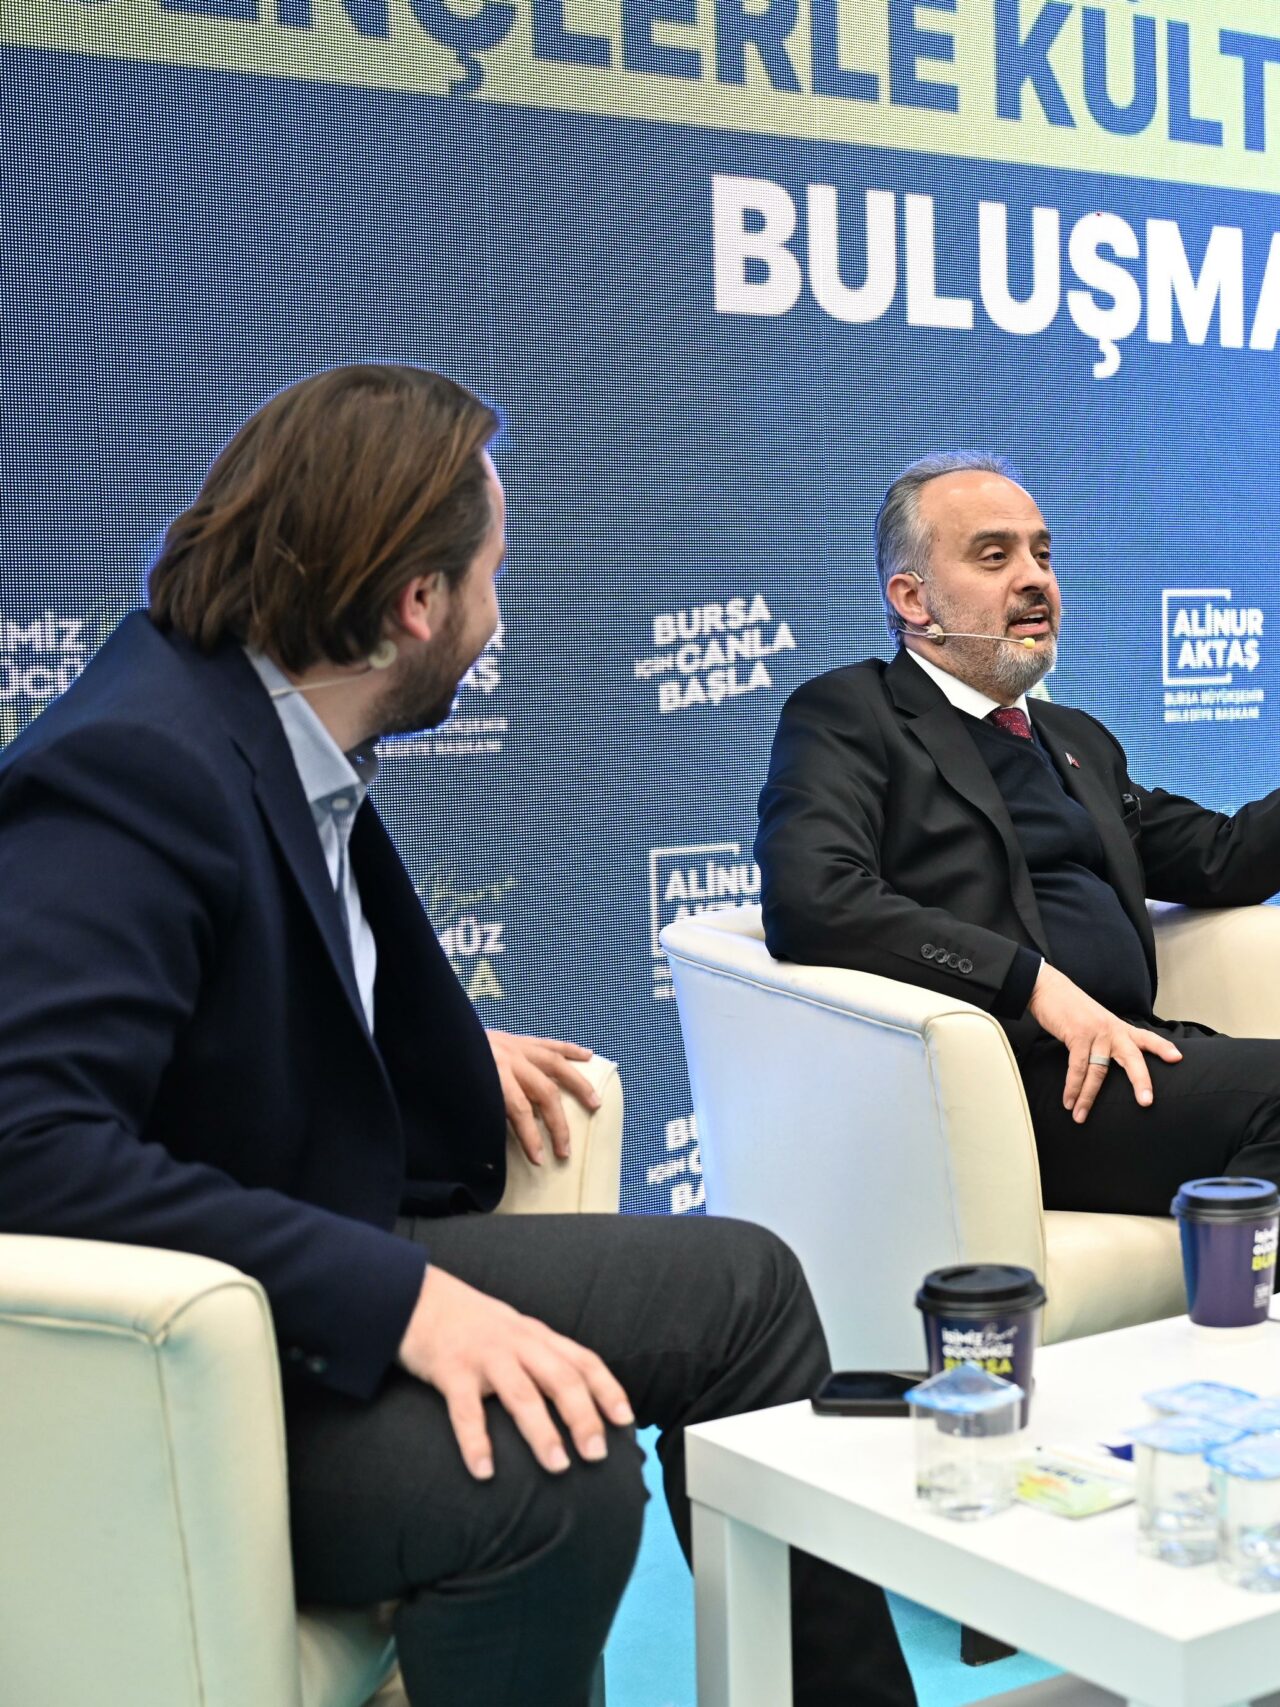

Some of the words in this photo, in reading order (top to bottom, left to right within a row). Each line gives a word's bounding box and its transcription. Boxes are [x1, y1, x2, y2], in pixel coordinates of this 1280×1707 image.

[160, 0, 960, 114] ÇLERLE
[653, 593, 772, 647] BURSA
[1172, 602, 1265, 638] ALİNUR
[675, 620, 798, 676] CANLA
[1177, 638, 1261, 671] AKTAŞ
[658, 659, 773, 715] BAŞLA
[664, 861, 762, 900] ALİNU
